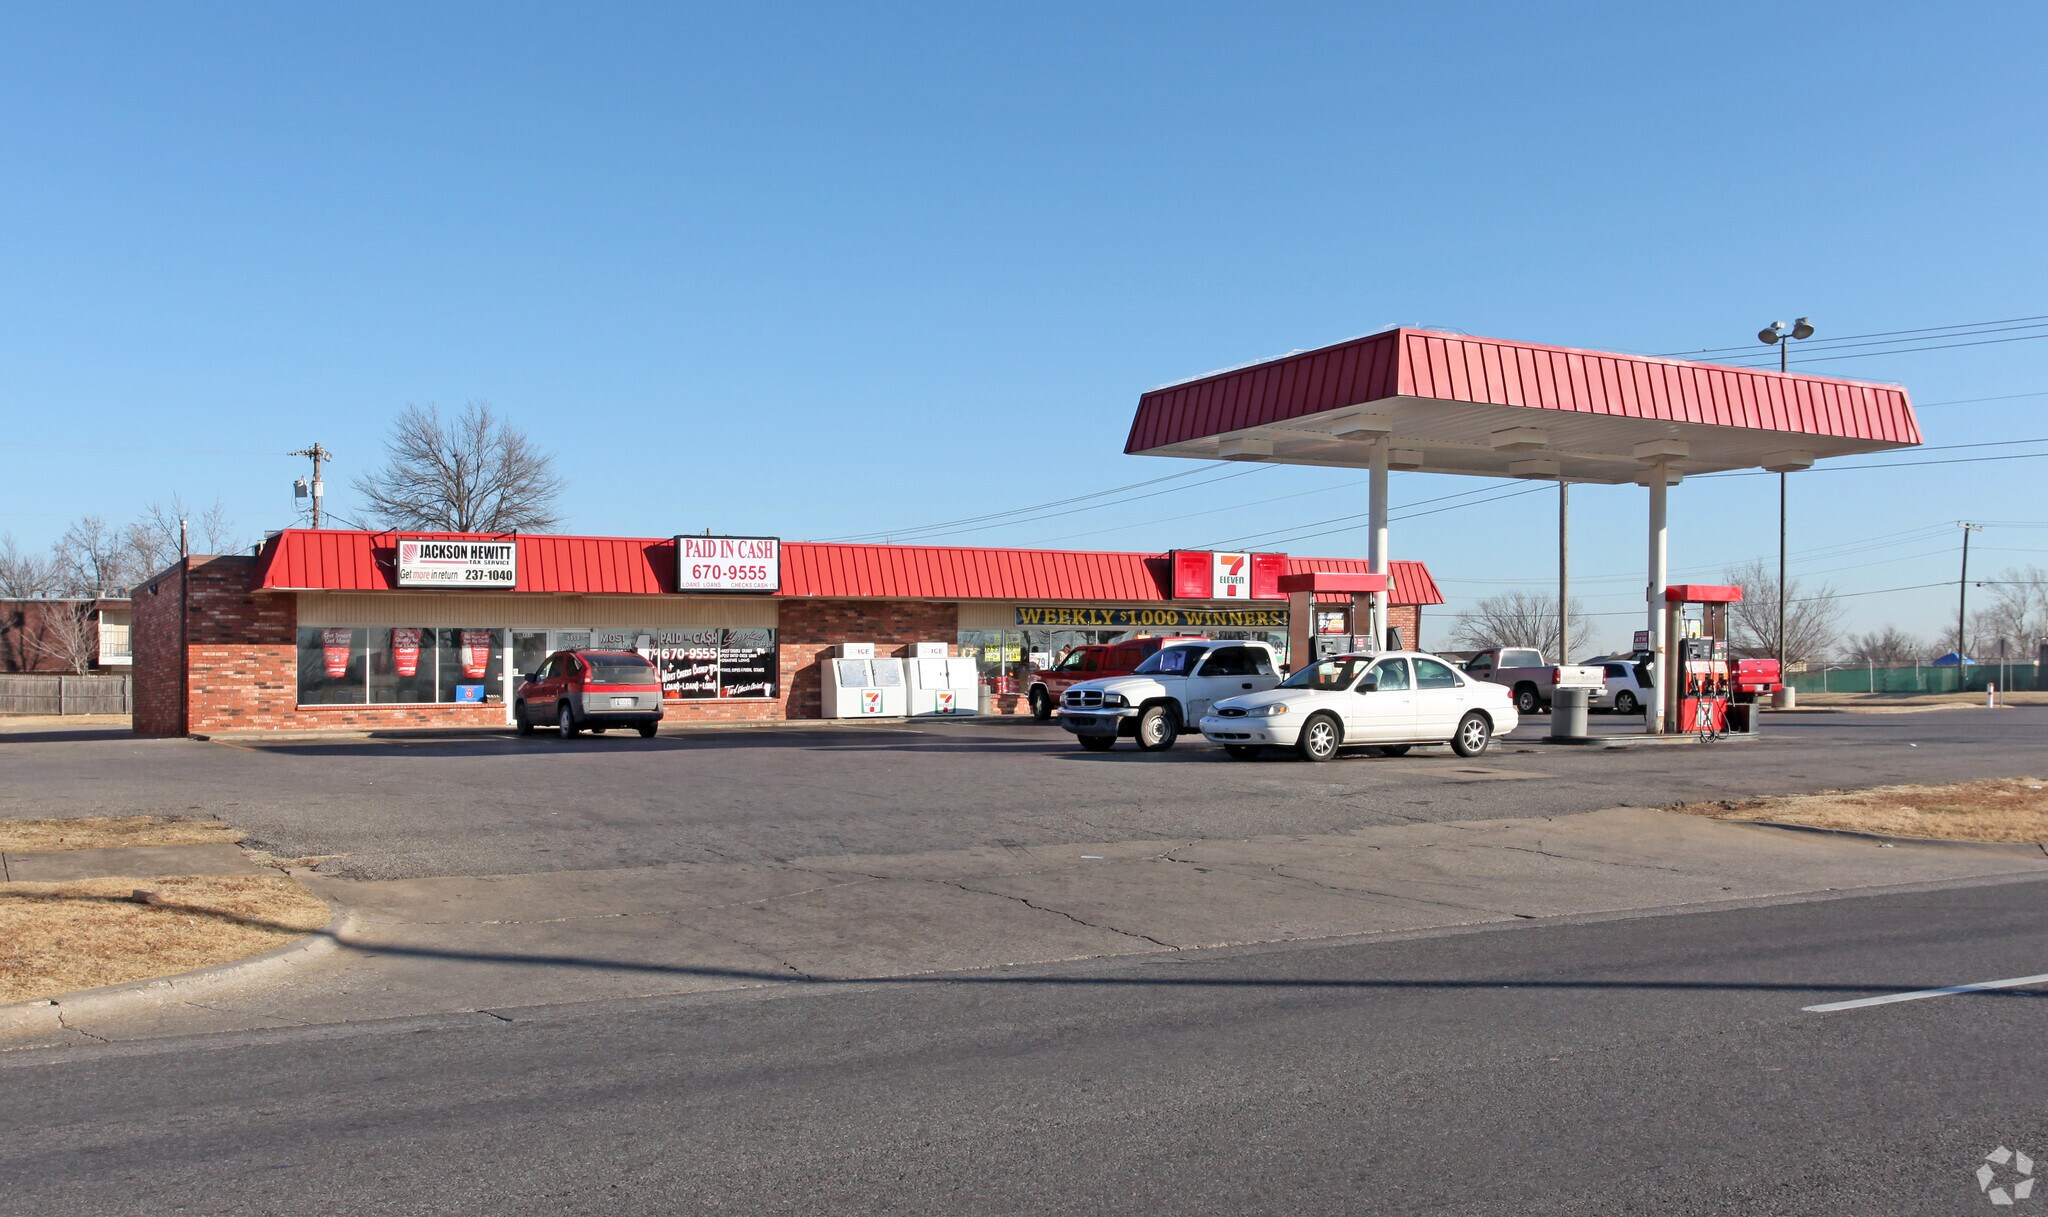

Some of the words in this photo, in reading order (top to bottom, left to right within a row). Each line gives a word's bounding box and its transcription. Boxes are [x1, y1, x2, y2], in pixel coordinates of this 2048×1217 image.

[419, 544, 467, 559] JACKSON
[471, 545, 511, 560] HEWITT
[685, 539, 717, 558] PAID
[720, 540, 734, 558] IN
[737, 540, 773, 559] CASH
[400, 568, 412, 579] Get
[413, 571, 430, 580] more
[430, 570, 438, 579] in
[438, 570, 458, 580] return
[465, 569, 513, 581] 237-1040
[692, 564, 767, 580] 670-9555
[1018, 607, 1115, 626] WEEKLY
[1120, 609, 1179, 627] $1,000
[1183, 610, 1289, 627] WINNERS!
[600, 634, 628, 644] MOST
[660, 632, 682, 645] PAID
[661, 648, 717, 660] 670-9555
[661, 669, 676, 683] MOST
